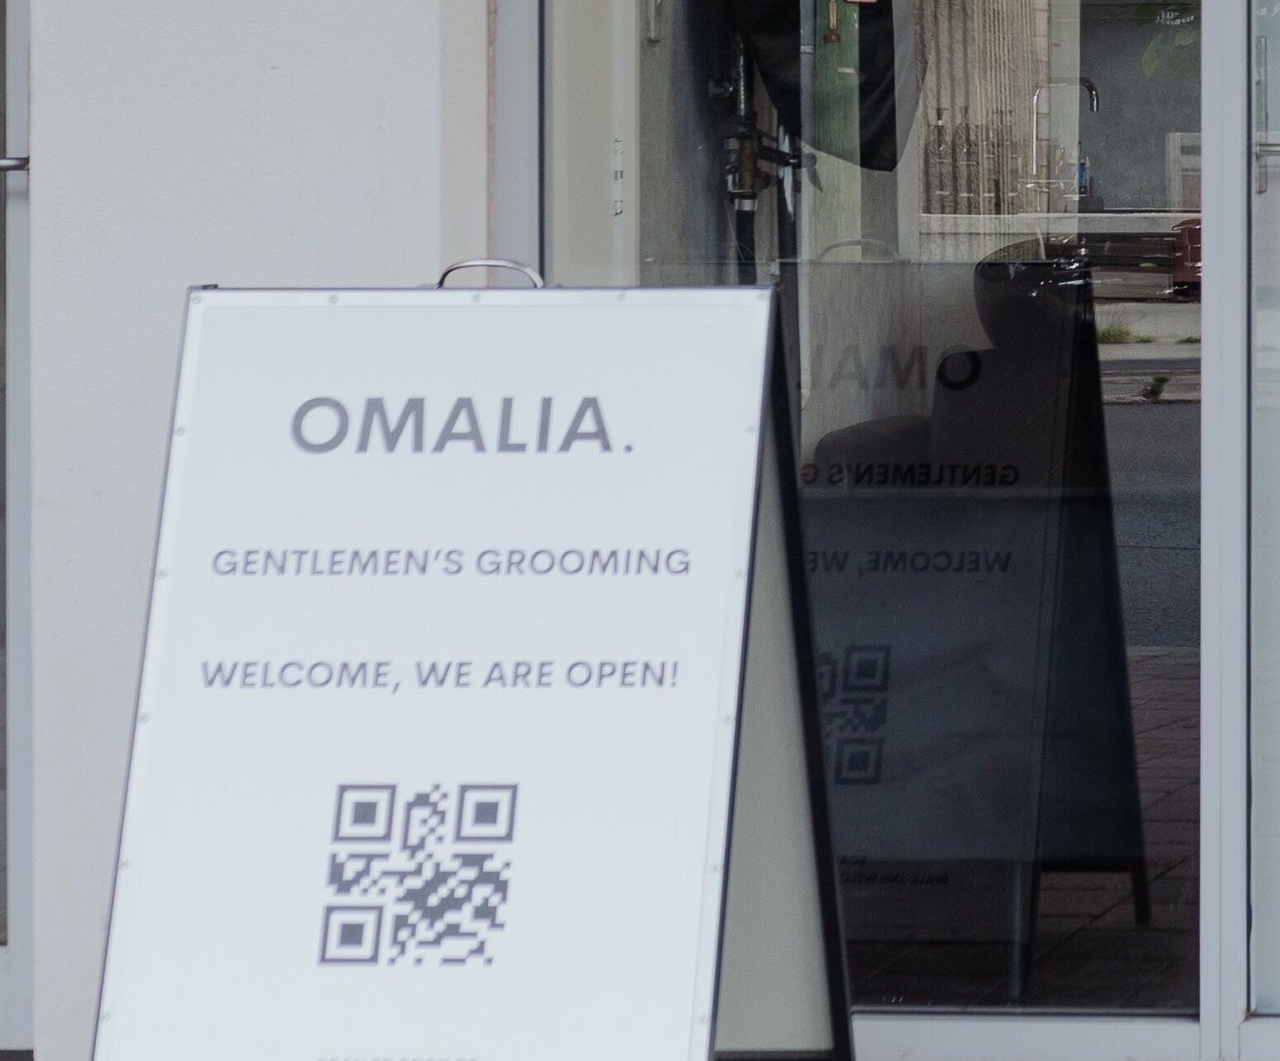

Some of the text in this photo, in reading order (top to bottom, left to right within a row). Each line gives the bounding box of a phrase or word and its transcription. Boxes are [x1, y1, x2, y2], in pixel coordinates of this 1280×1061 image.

[290, 396, 634, 455] OMALIA.
[211, 548, 692, 577] GENTLEMEN'S GROOMING
[201, 659, 680, 695] WELCOME, WE ARE OPEN!
